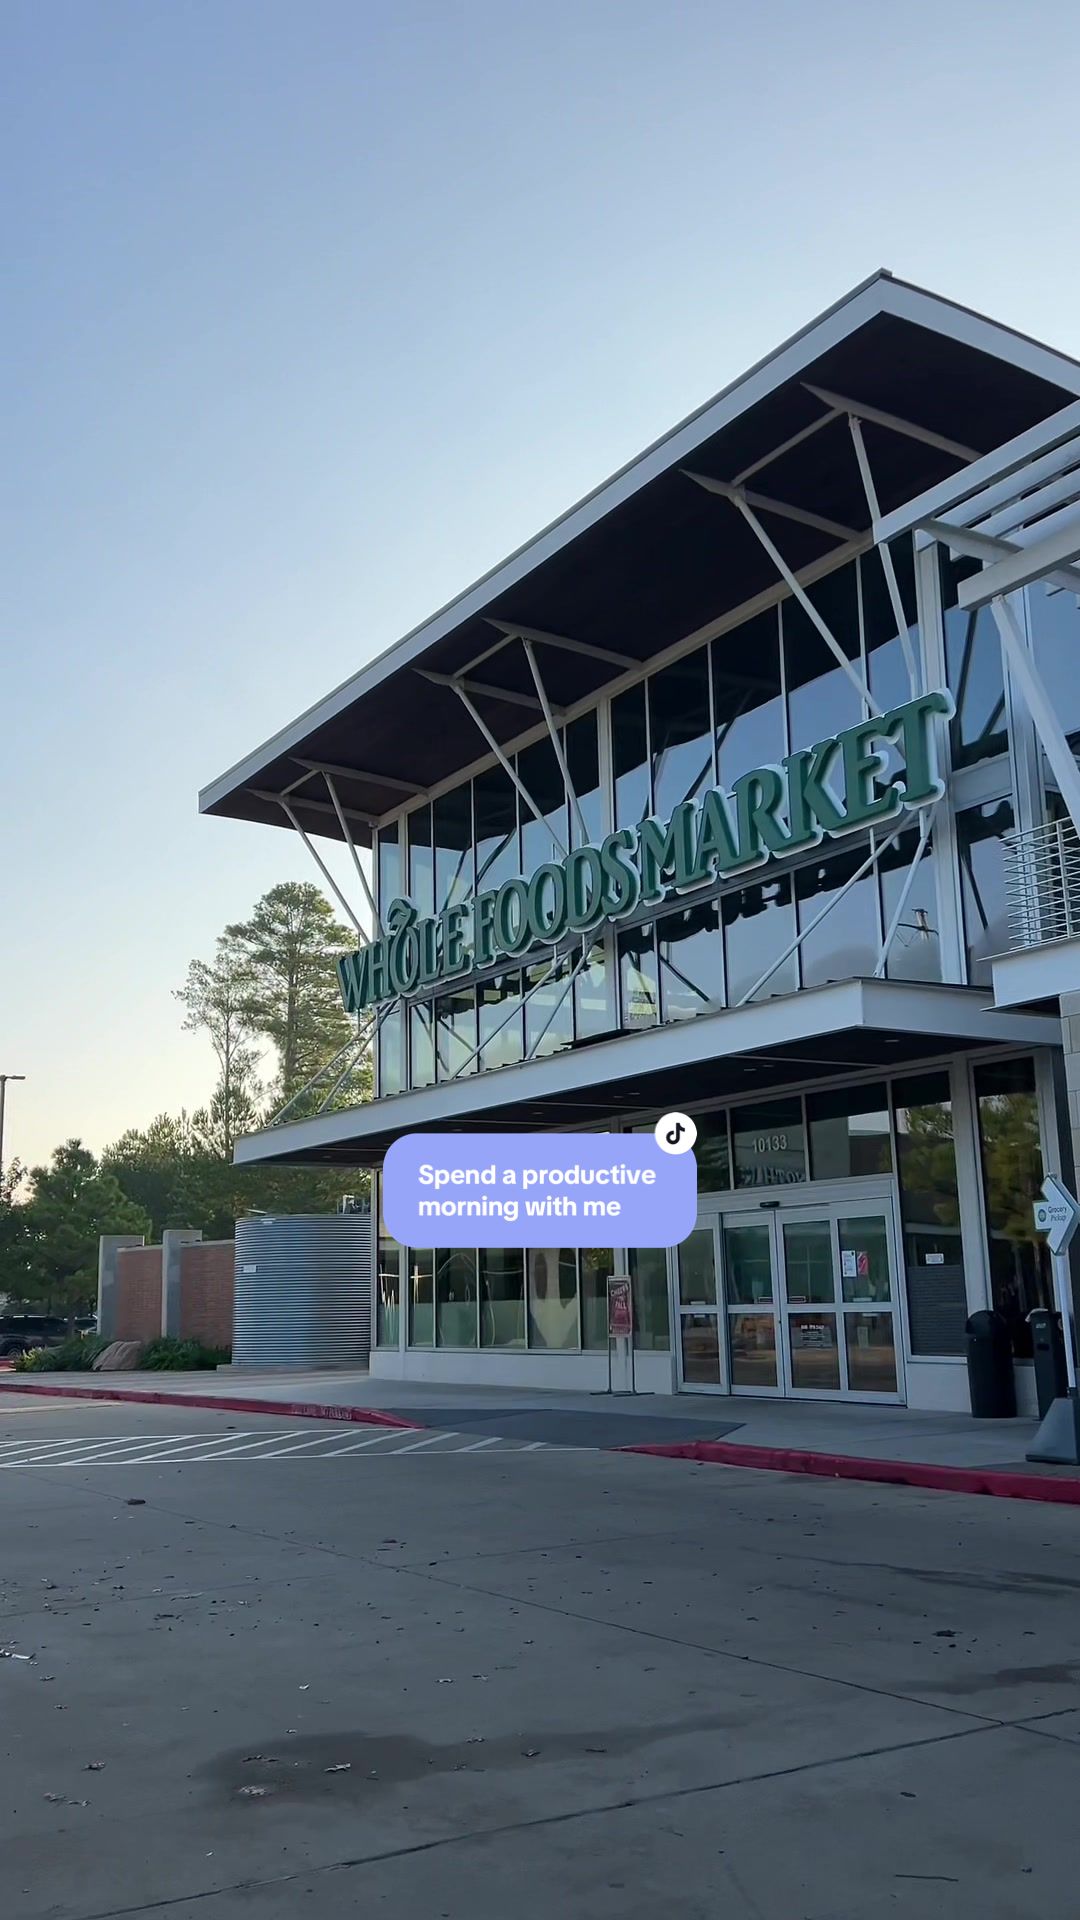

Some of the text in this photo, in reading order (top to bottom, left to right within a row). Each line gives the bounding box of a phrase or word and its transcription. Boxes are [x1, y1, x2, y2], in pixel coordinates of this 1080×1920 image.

[337, 690, 956, 1013] WHOLE FOODS MARKET
[752, 1135, 787, 1153] 10133
